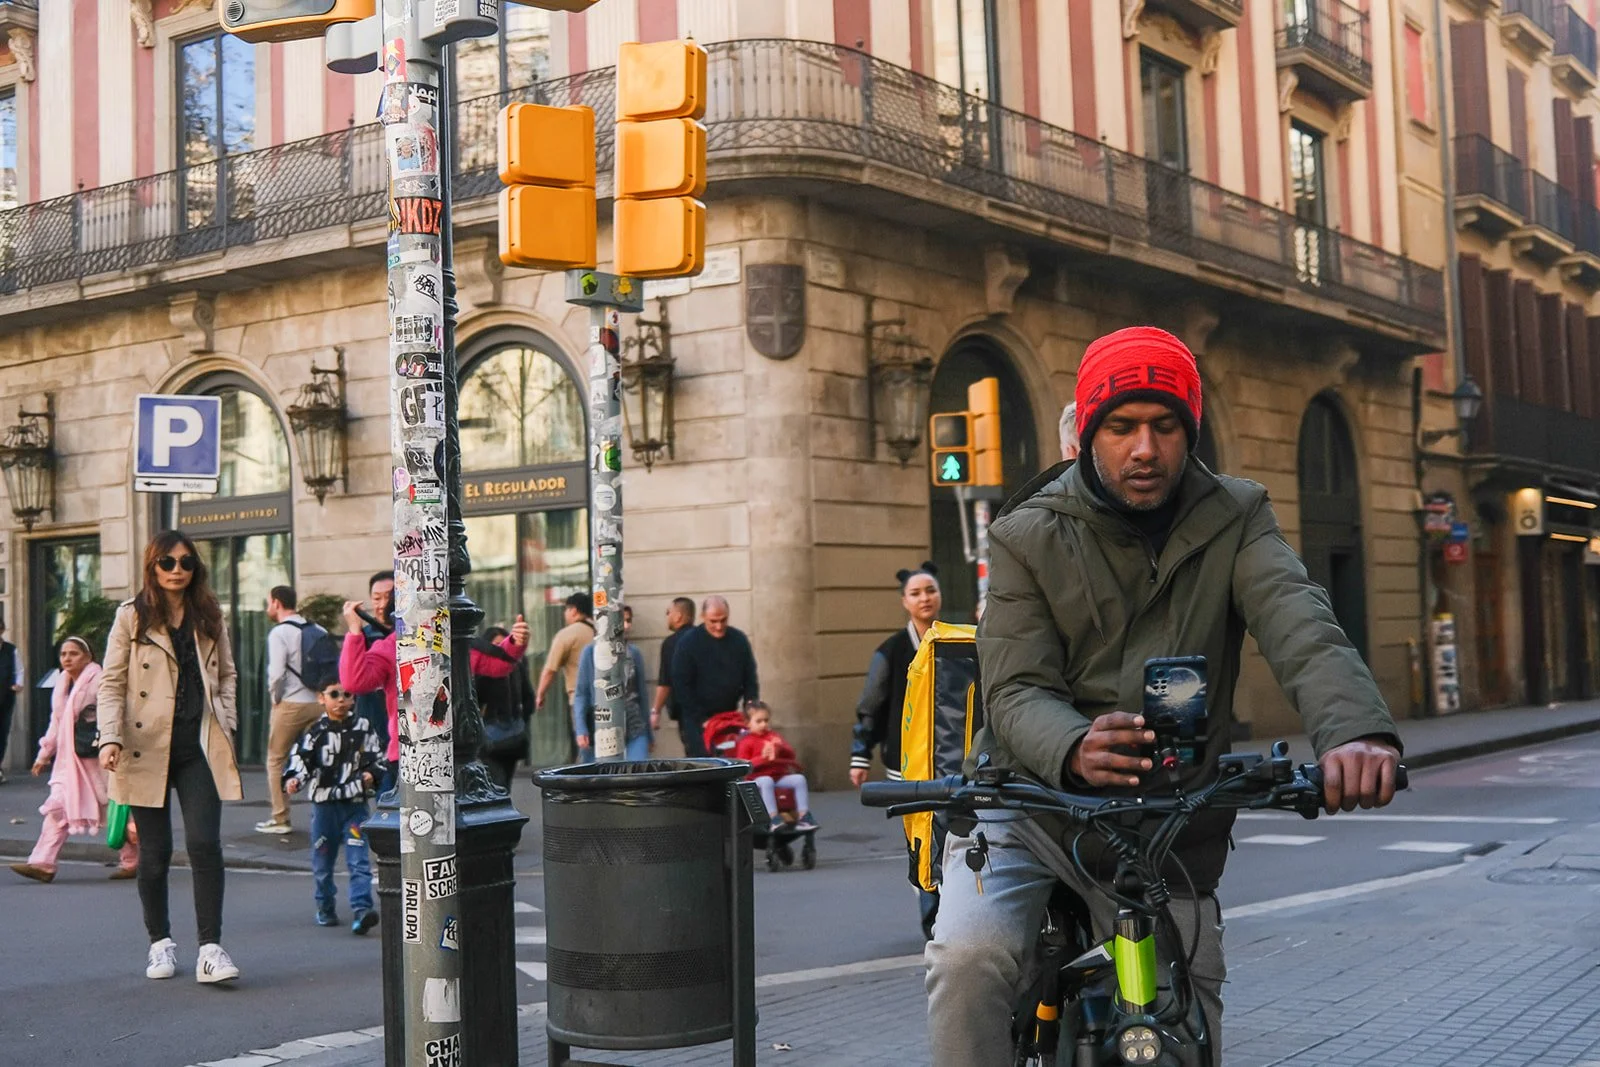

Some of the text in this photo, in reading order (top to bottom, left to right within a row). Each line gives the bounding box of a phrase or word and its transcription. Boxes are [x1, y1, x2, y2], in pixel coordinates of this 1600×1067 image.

[152, 405, 203, 467] P
[465, 477, 566, 498] EL REGULADOR
[181, 508, 278, 525] RESTAURANT BISTROT
[405, 882, 418, 940] FARLOPA
